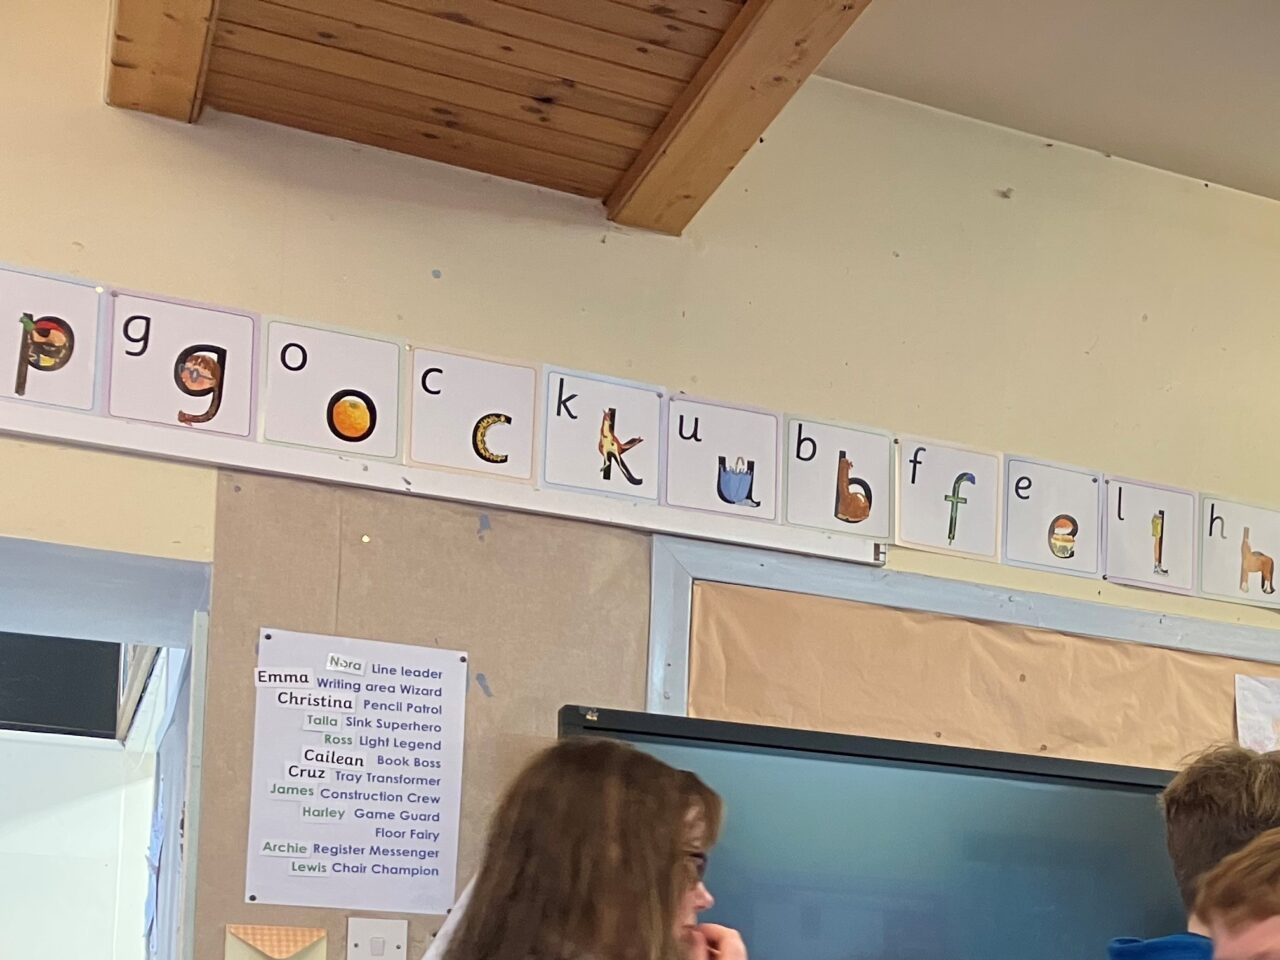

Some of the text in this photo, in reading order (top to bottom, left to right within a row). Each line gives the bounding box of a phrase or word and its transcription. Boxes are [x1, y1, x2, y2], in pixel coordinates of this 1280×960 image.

[123, 315, 151, 357] g
[280, 342, 309, 372] o
[174, 344, 227, 427] g
[420, 366, 444, 395] c
[556, 378, 578, 420] k
[326, 388, 377, 442] o
[678, 411, 703, 443] u
[471, 412, 512, 464] c
[597, 407, 643, 487] k
[796, 422, 818, 462] b
[908, 447, 927, 485] f
[717, 455, 761, 509] u
[835, 449, 873, 525] b
[1015, 476, 1033, 500] e
[944, 471, 977, 546] f
[1209, 504, 1227, 540] h
[1048, 513, 1079, 559] e
[1238, 526, 1276, 596] h
[258, 670, 443, 697] Emma Writing area Wizard
[371, 663, 397, 676] Line
[401, 667, 443, 680] leader
[277, 692, 443, 715] Christina Pencil Patrol
[345, 716, 372, 728] Sink
[376, 718, 442, 733] Superhero
[324, 734, 442, 752] Ross Light Legend
[304, 749, 442, 769] Cailean Book Boss
[288, 765, 441, 787] Cruz Tray Transformer
[270, 784, 440, 804] James Construction Crew
[302, 807, 440, 822] Harley Game Guard
[375, 828, 440, 841] Floor Fairy
[263, 841, 439, 860] Archie Register Messenger
[291, 861, 439, 877] Lewis Chair Champion
